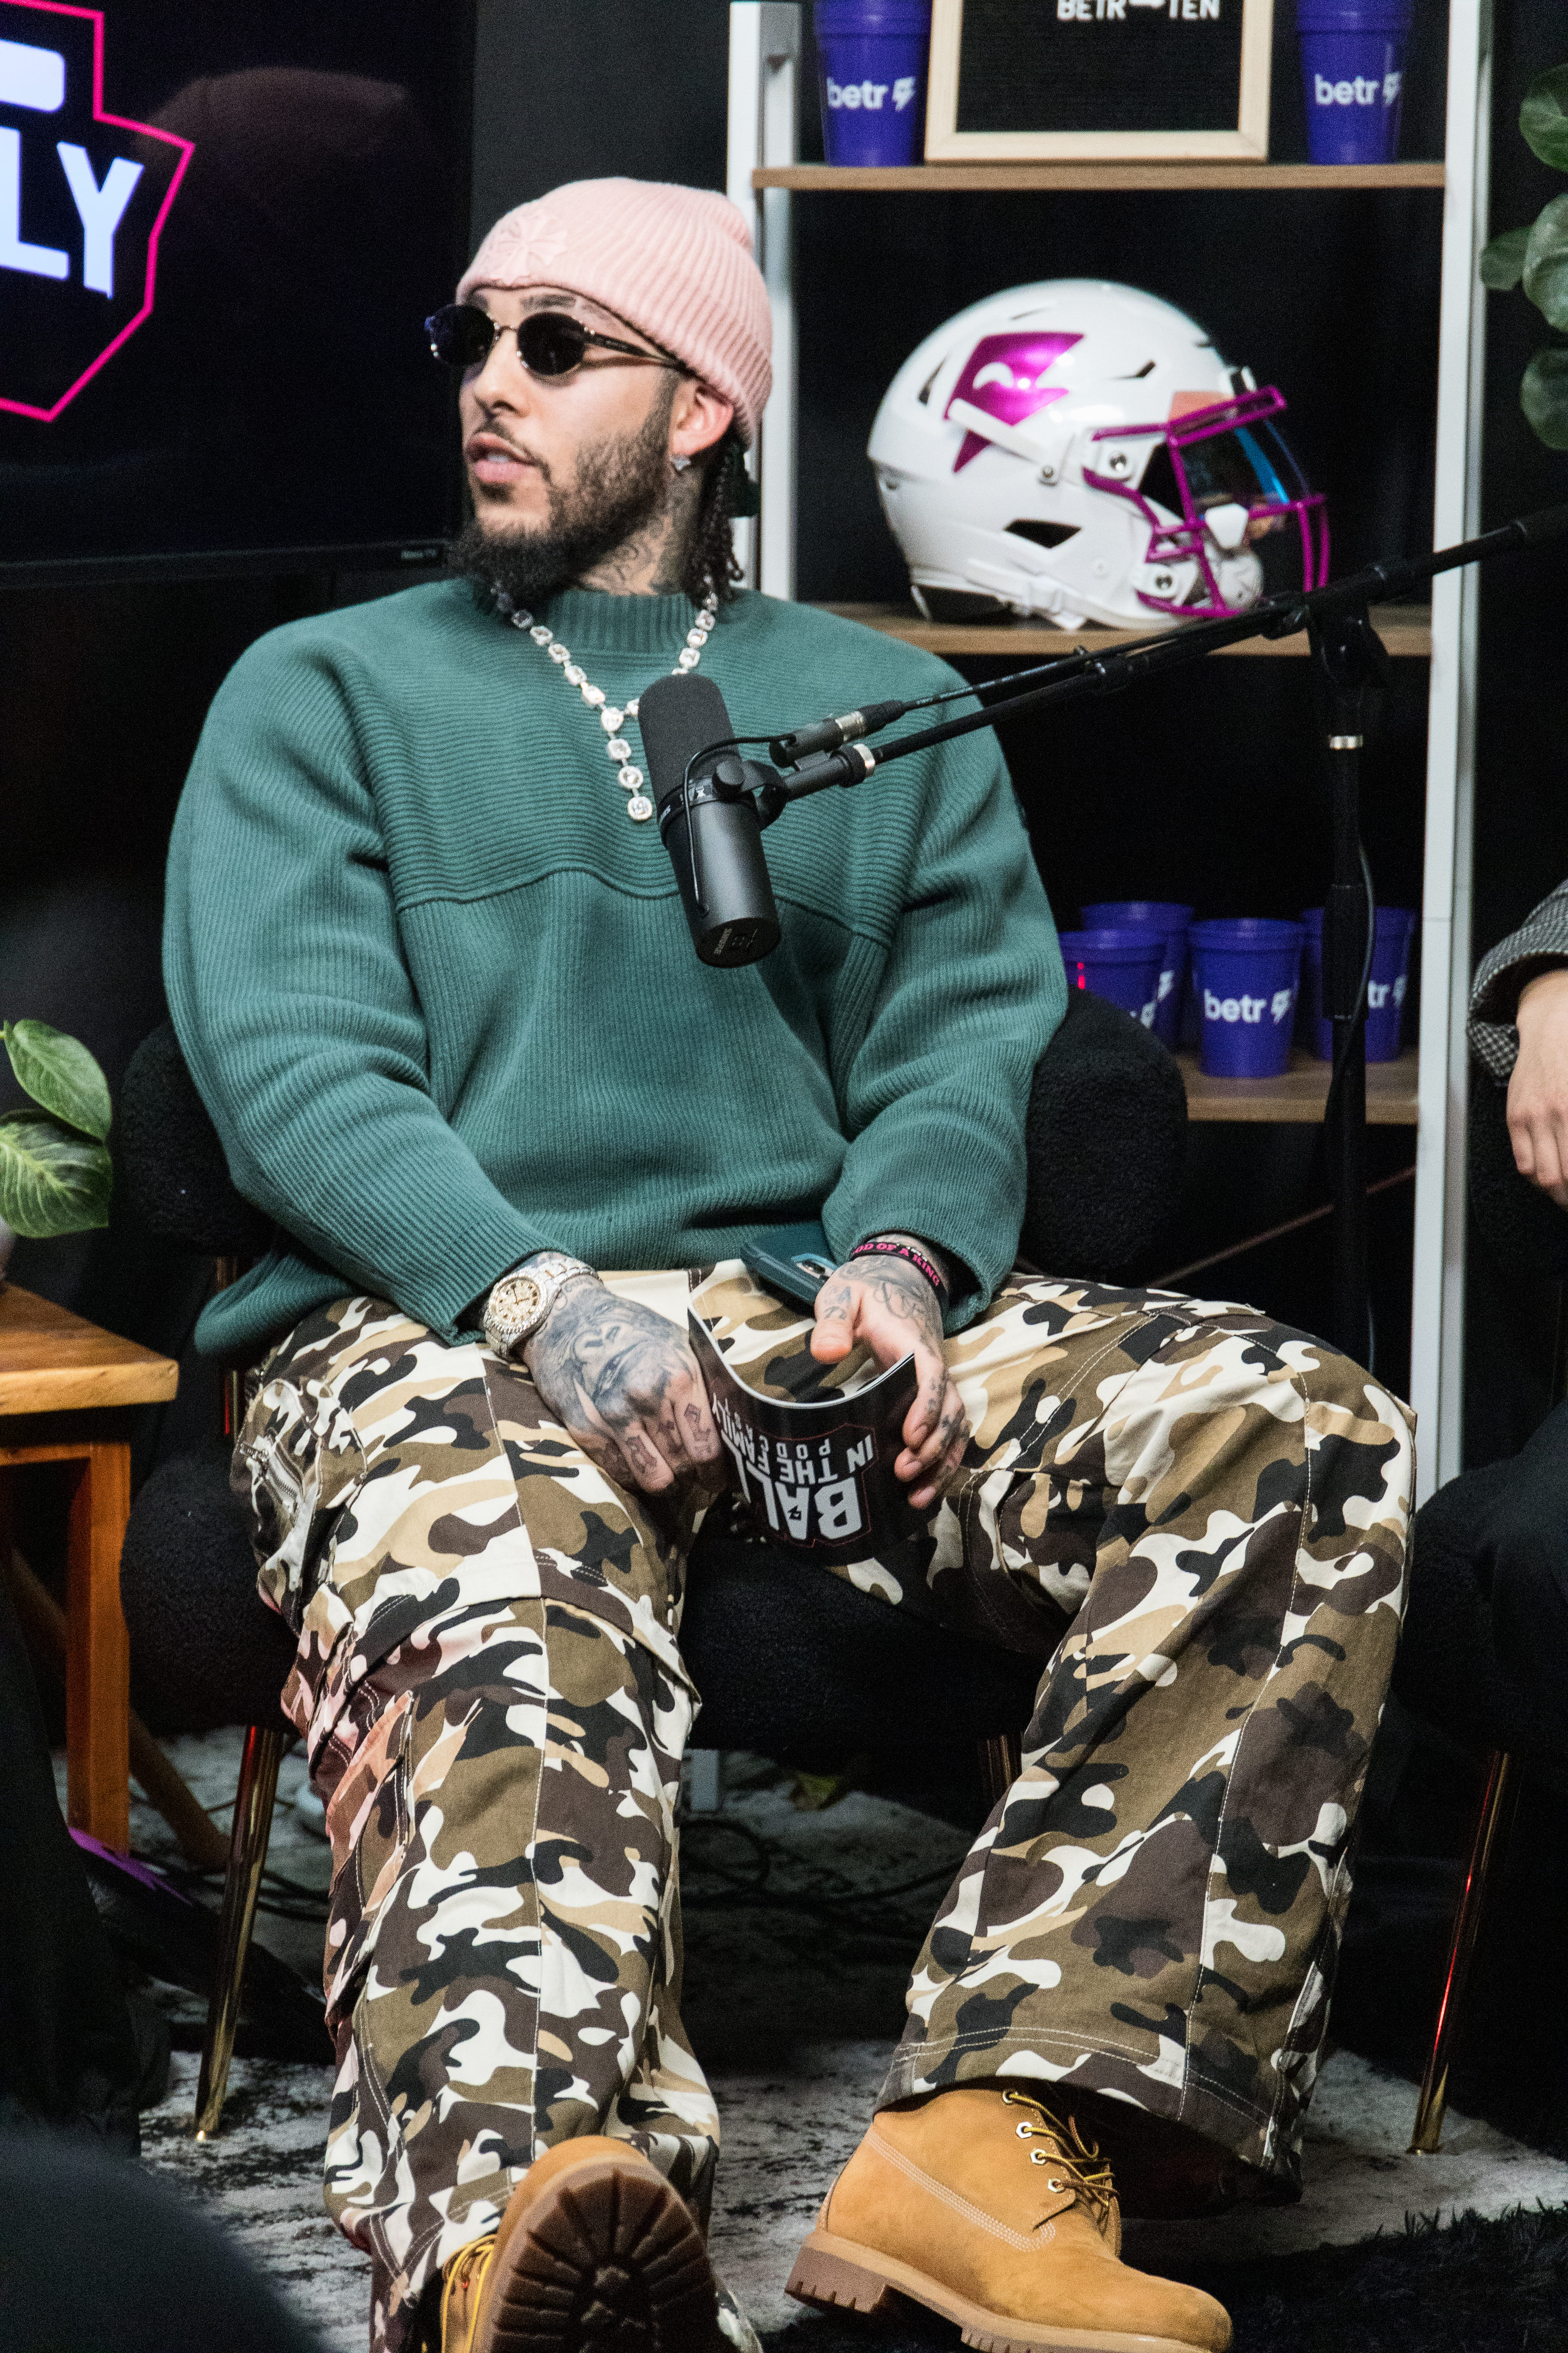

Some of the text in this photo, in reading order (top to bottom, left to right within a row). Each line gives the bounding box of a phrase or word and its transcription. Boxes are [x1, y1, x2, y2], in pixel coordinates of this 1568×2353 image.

[827, 77, 889, 110] betr
[1315, 74, 1380, 106] betr
[1204, 988, 1267, 1023] betr
[1368, 980, 1390, 1008] tr
[876, 1243, 897, 1251] OF
[899, 1248, 909, 1257] A
[912, 1253, 940, 1286] KING
[776, 1457, 838, 1485] THE
[846, 1434, 874, 1474] IN
[720, 1430, 862, 1540] BALL
